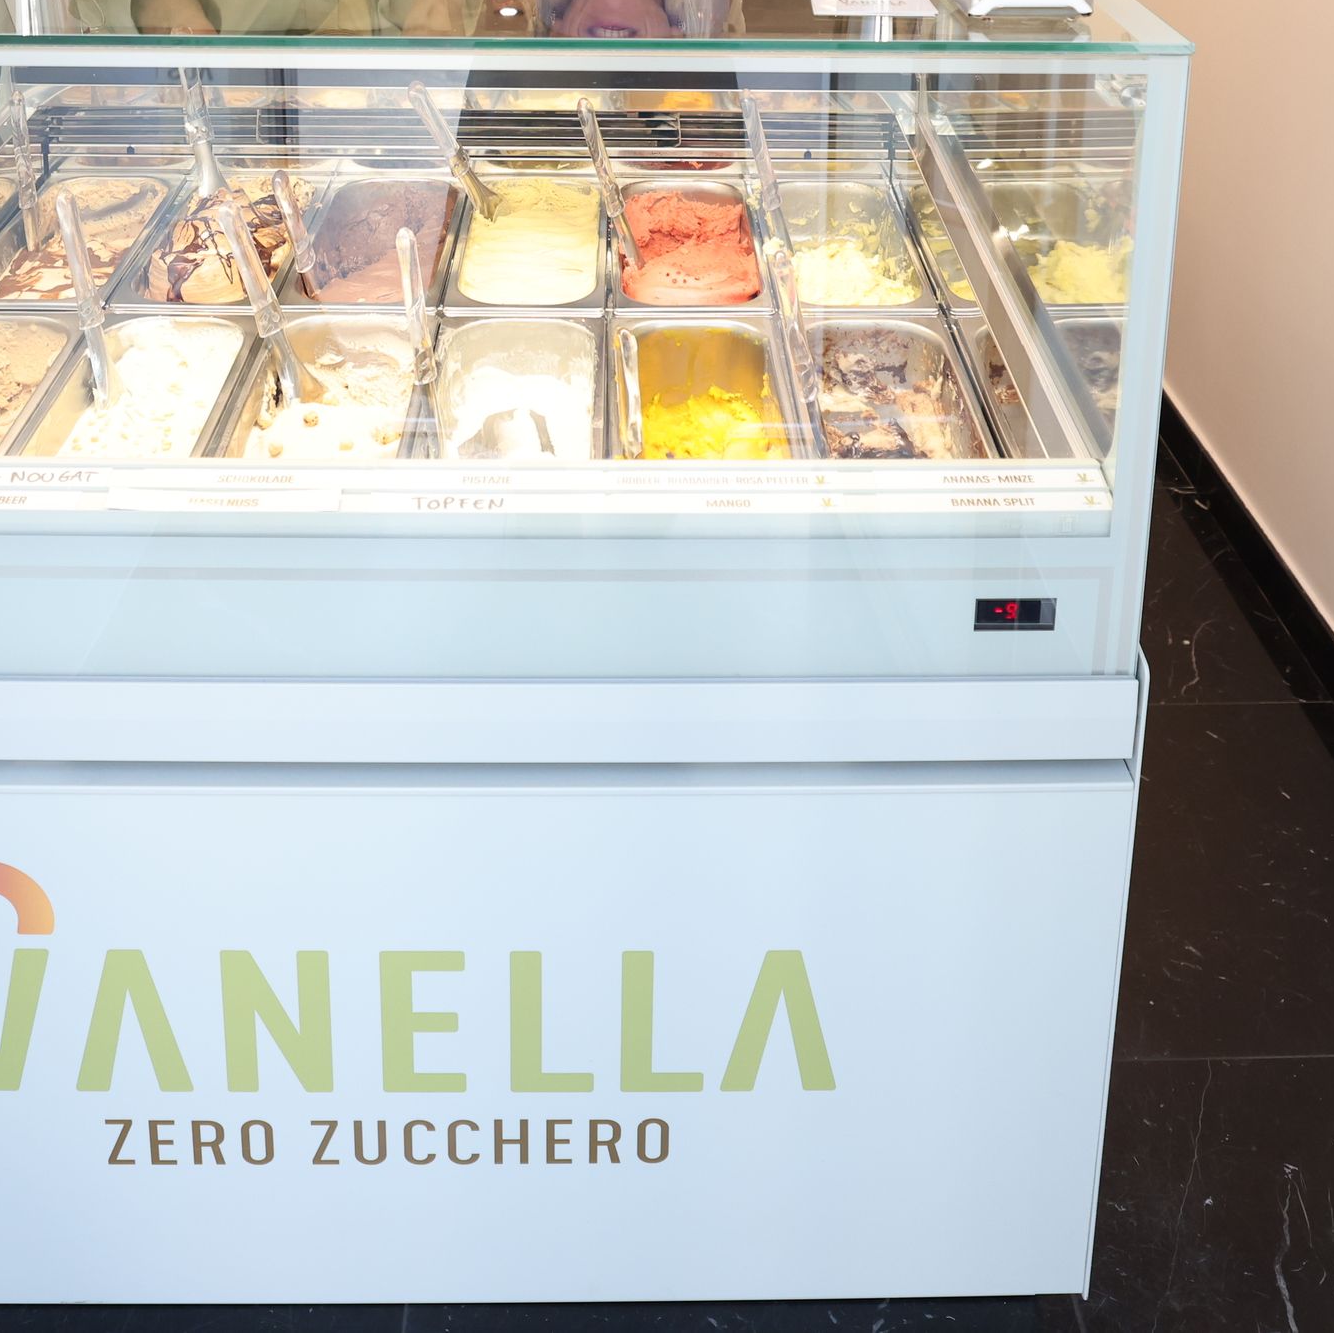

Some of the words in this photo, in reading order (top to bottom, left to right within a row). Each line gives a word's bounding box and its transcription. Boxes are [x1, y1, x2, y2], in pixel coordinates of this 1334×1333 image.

[10, 469, 99, 484] NOUGAT
[217, 474, 296, 484] SCHOKOLADE
[462, 475, 511, 485] PISTAZIE
[412, 496, 505, 511] TOPFEN
[706, 499, 752, 508] MANGO
[949, 497, 1002, 507] BANANA
[1003, 497, 1036, 507] SPLIT
[103, 1117, 275, 1165] ZERO
[309, 1117, 671, 1165] ZUCCHERO
